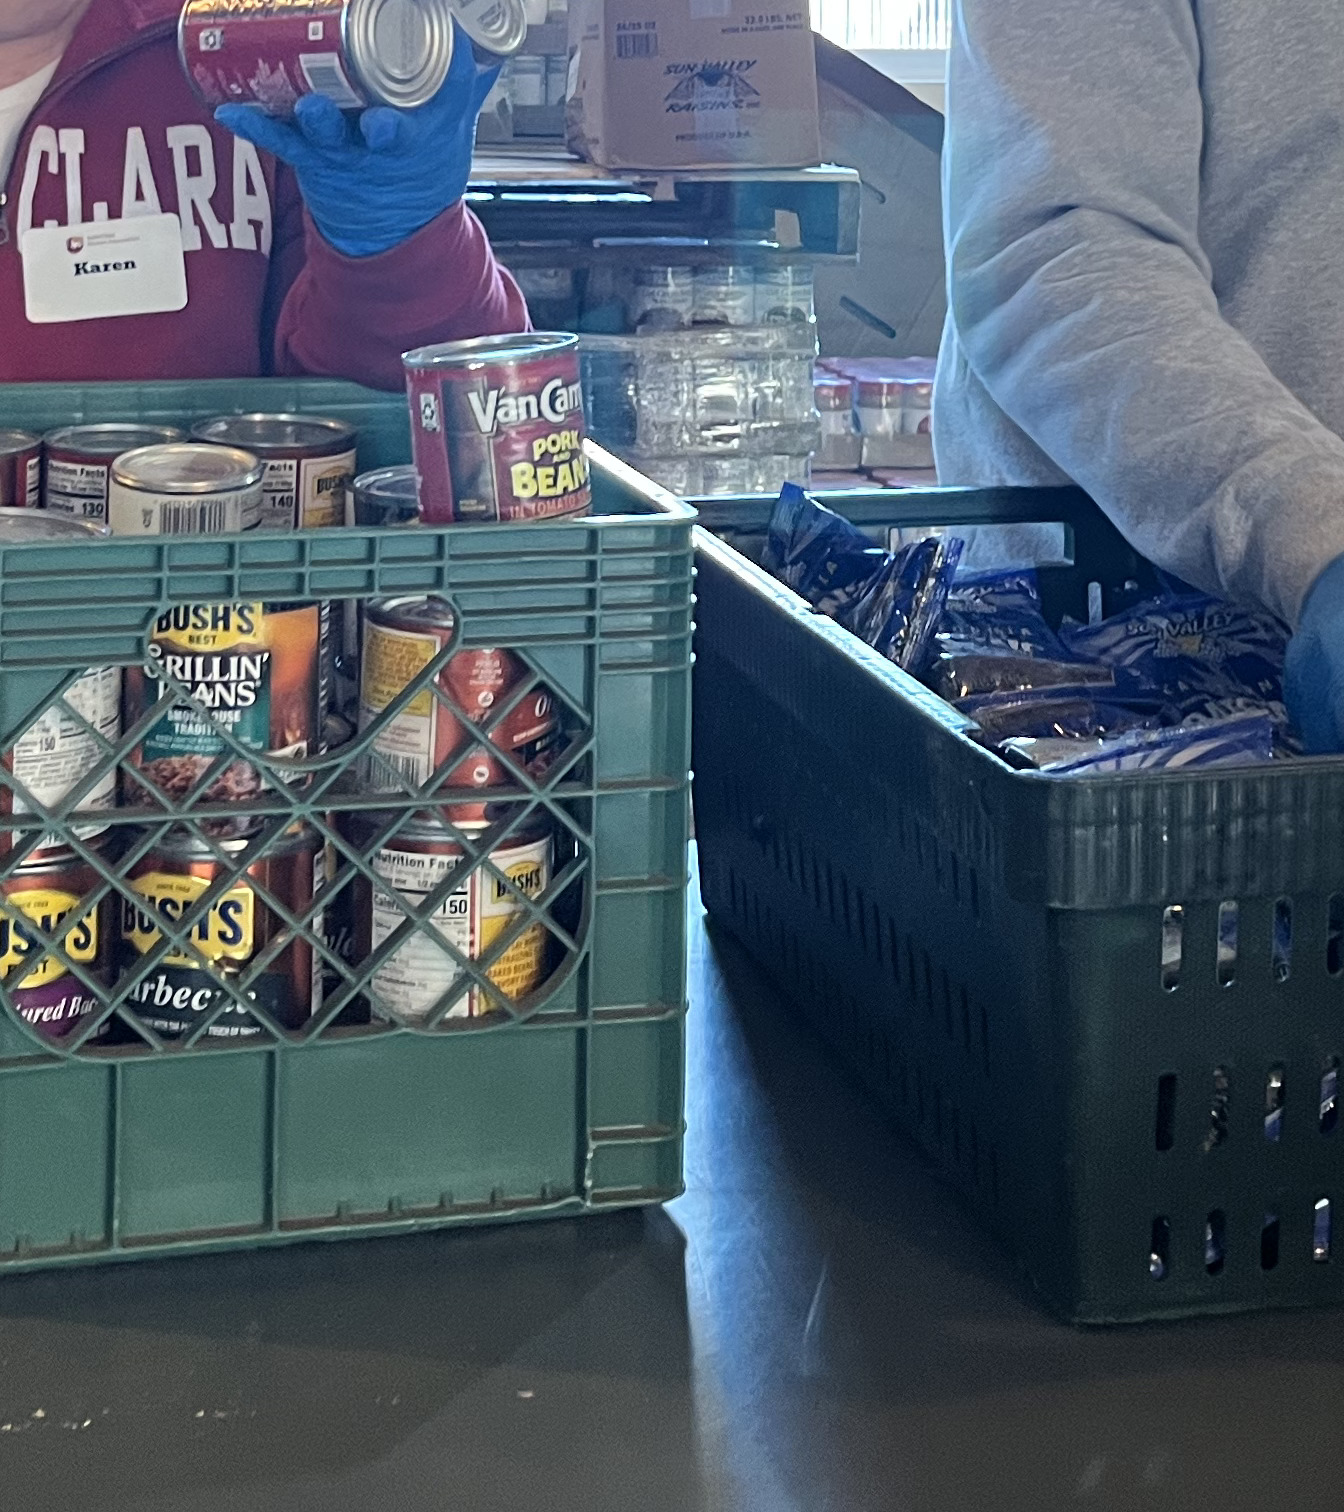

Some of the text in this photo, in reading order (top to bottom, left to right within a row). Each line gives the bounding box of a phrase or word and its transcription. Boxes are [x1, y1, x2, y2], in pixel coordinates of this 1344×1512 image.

[663, 63, 698, 75] SUN
[16, 123, 272, 257] CLARA
[74, 259, 137, 276] Karen
[467, 390, 538, 434] Van
[532, 429, 580, 462] PORK
[81, 502, 104, 516] 130
[270, 495, 294, 508] 140
[156, 602, 256, 635] BUSH'S
[442, 899, 468, 915] 150
